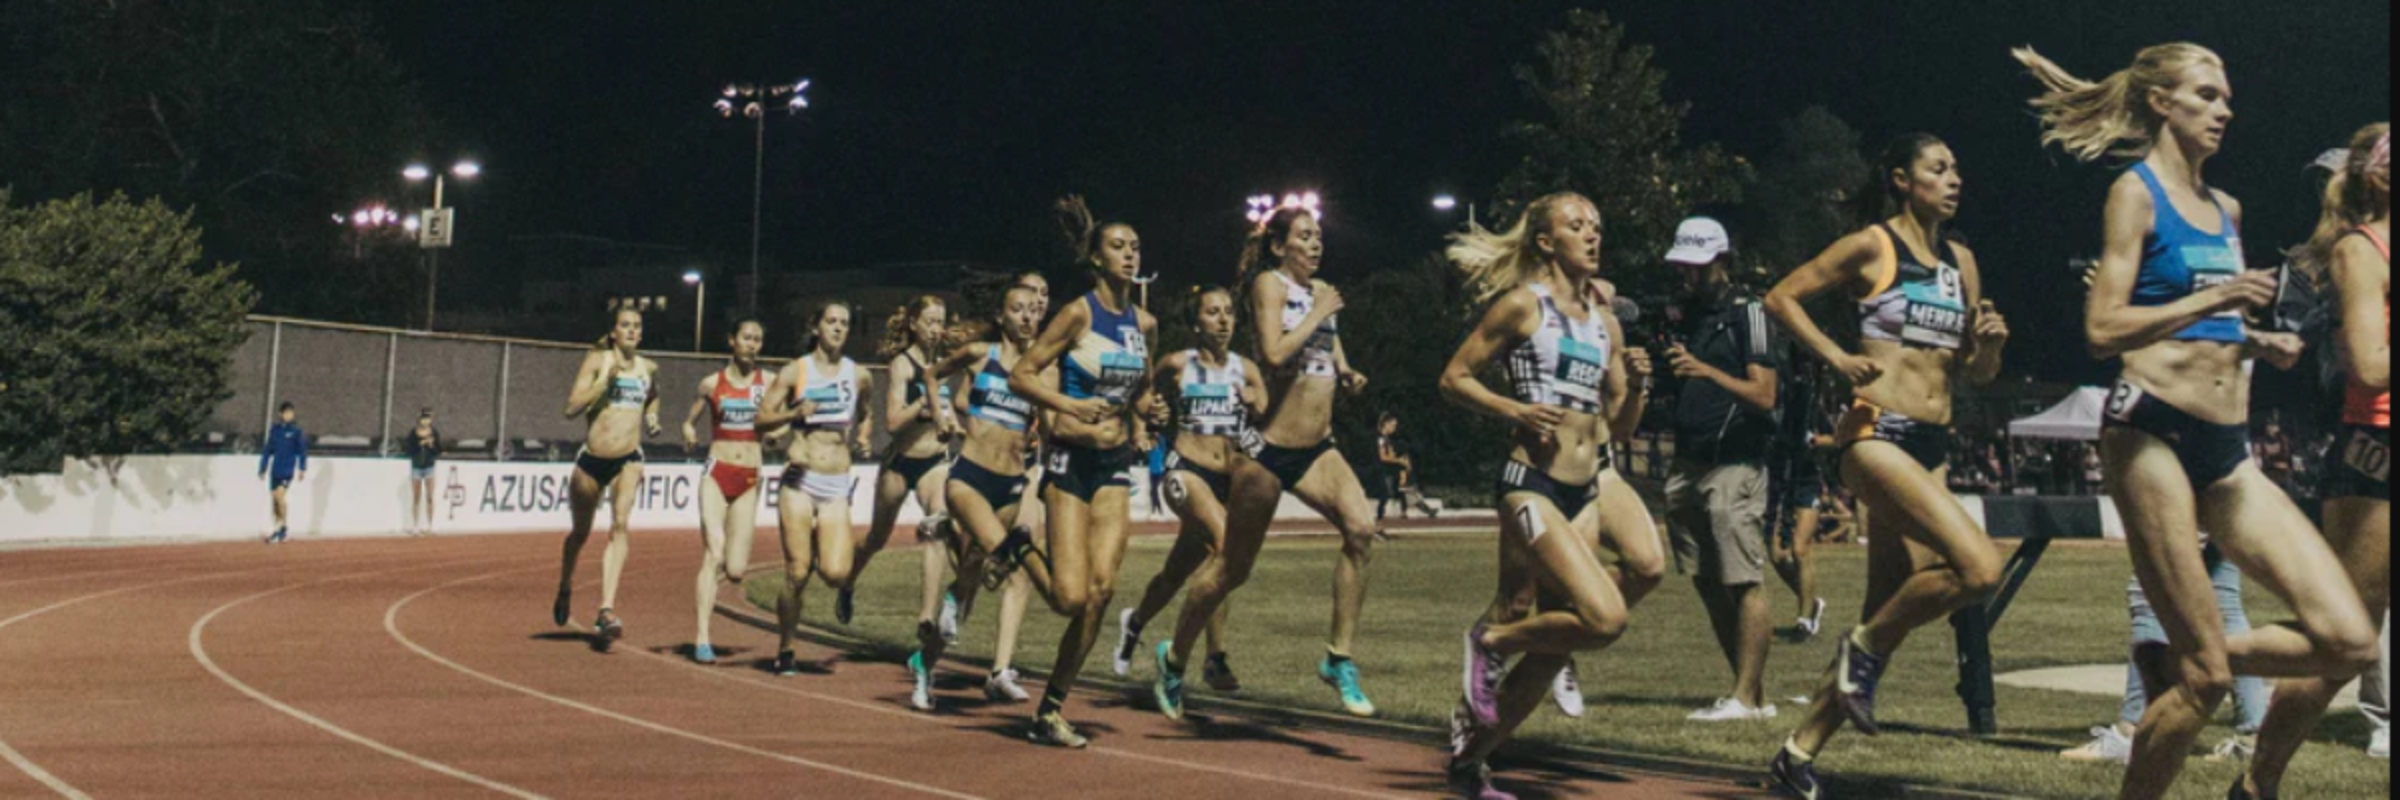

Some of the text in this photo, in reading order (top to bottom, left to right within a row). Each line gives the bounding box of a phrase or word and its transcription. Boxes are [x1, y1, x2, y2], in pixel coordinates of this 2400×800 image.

[1941, 266, 1956, 298] 9
[841, 379, 853, 403] 5
[2111, 383, 2132, 415] 3
[2355, 438, 2387, 473] 10
[479, 474, 571, 512] AZUSA
[1517, 504, 1535, 540] 7
